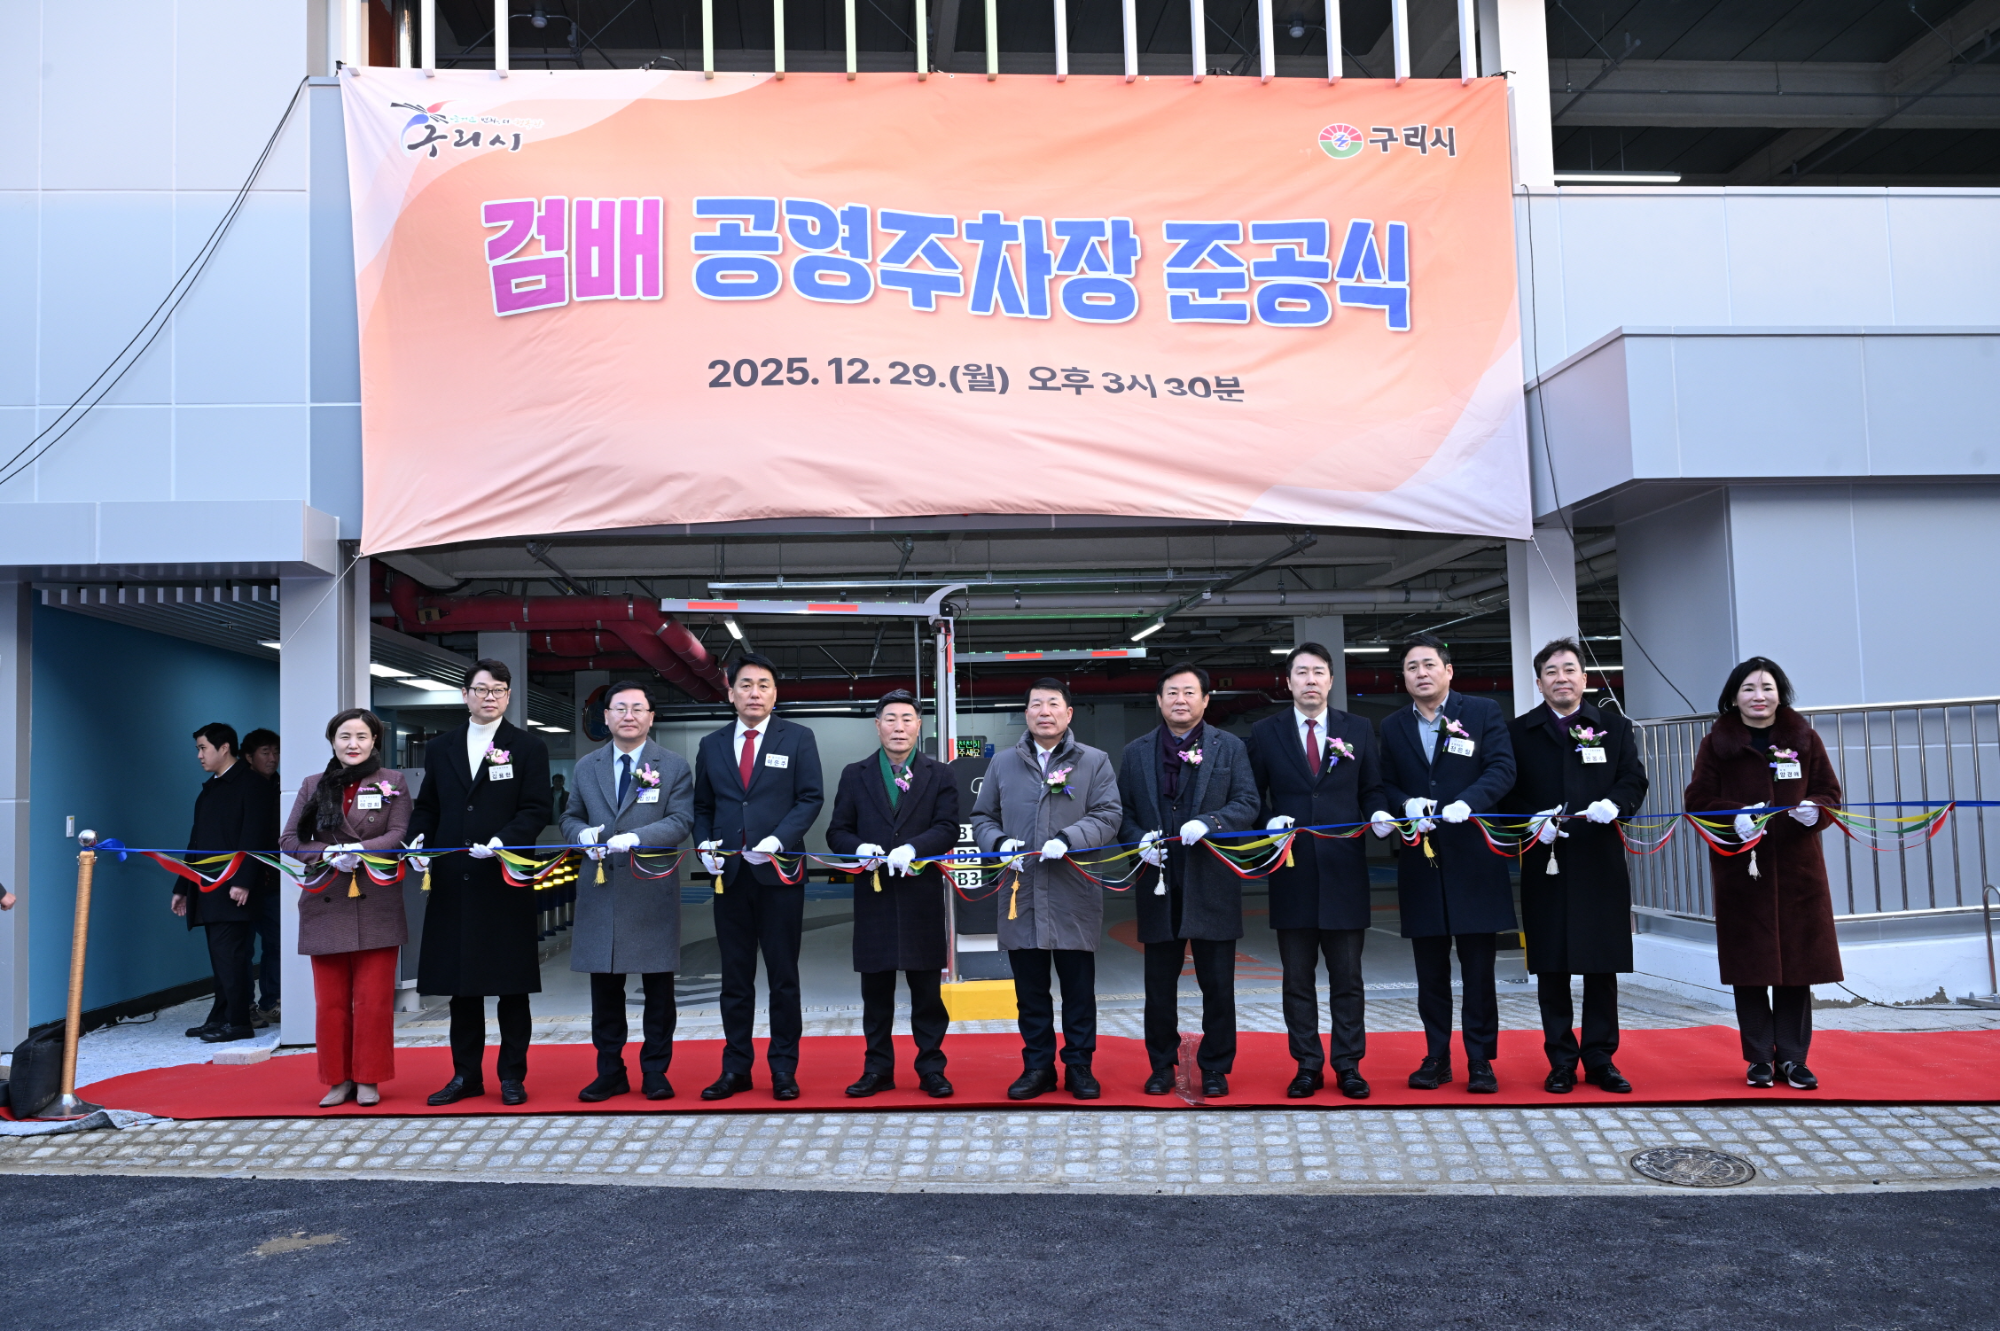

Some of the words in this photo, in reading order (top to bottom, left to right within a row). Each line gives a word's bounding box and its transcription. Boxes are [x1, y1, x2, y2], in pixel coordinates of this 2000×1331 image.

[406, 124, 521, 157] 구리시
[1368, 124, 1456, 157] 구리시
[482, 197, 662, 316] 검배
[691, 197, 1140, 324] 공영주차장
[1163, 219, 1411, 331] 준공식
[708, 357, 819, 387] 2025.
[827, 357, 881, 385] 12.
[1028, 366, 1094, 395] 오후
[1101, 372, 1158, 399] 3시
[1163, 376, 1245, 403] 30분
[957, 849, 979, 864] B2
[957, 871, 980, 887] B3
